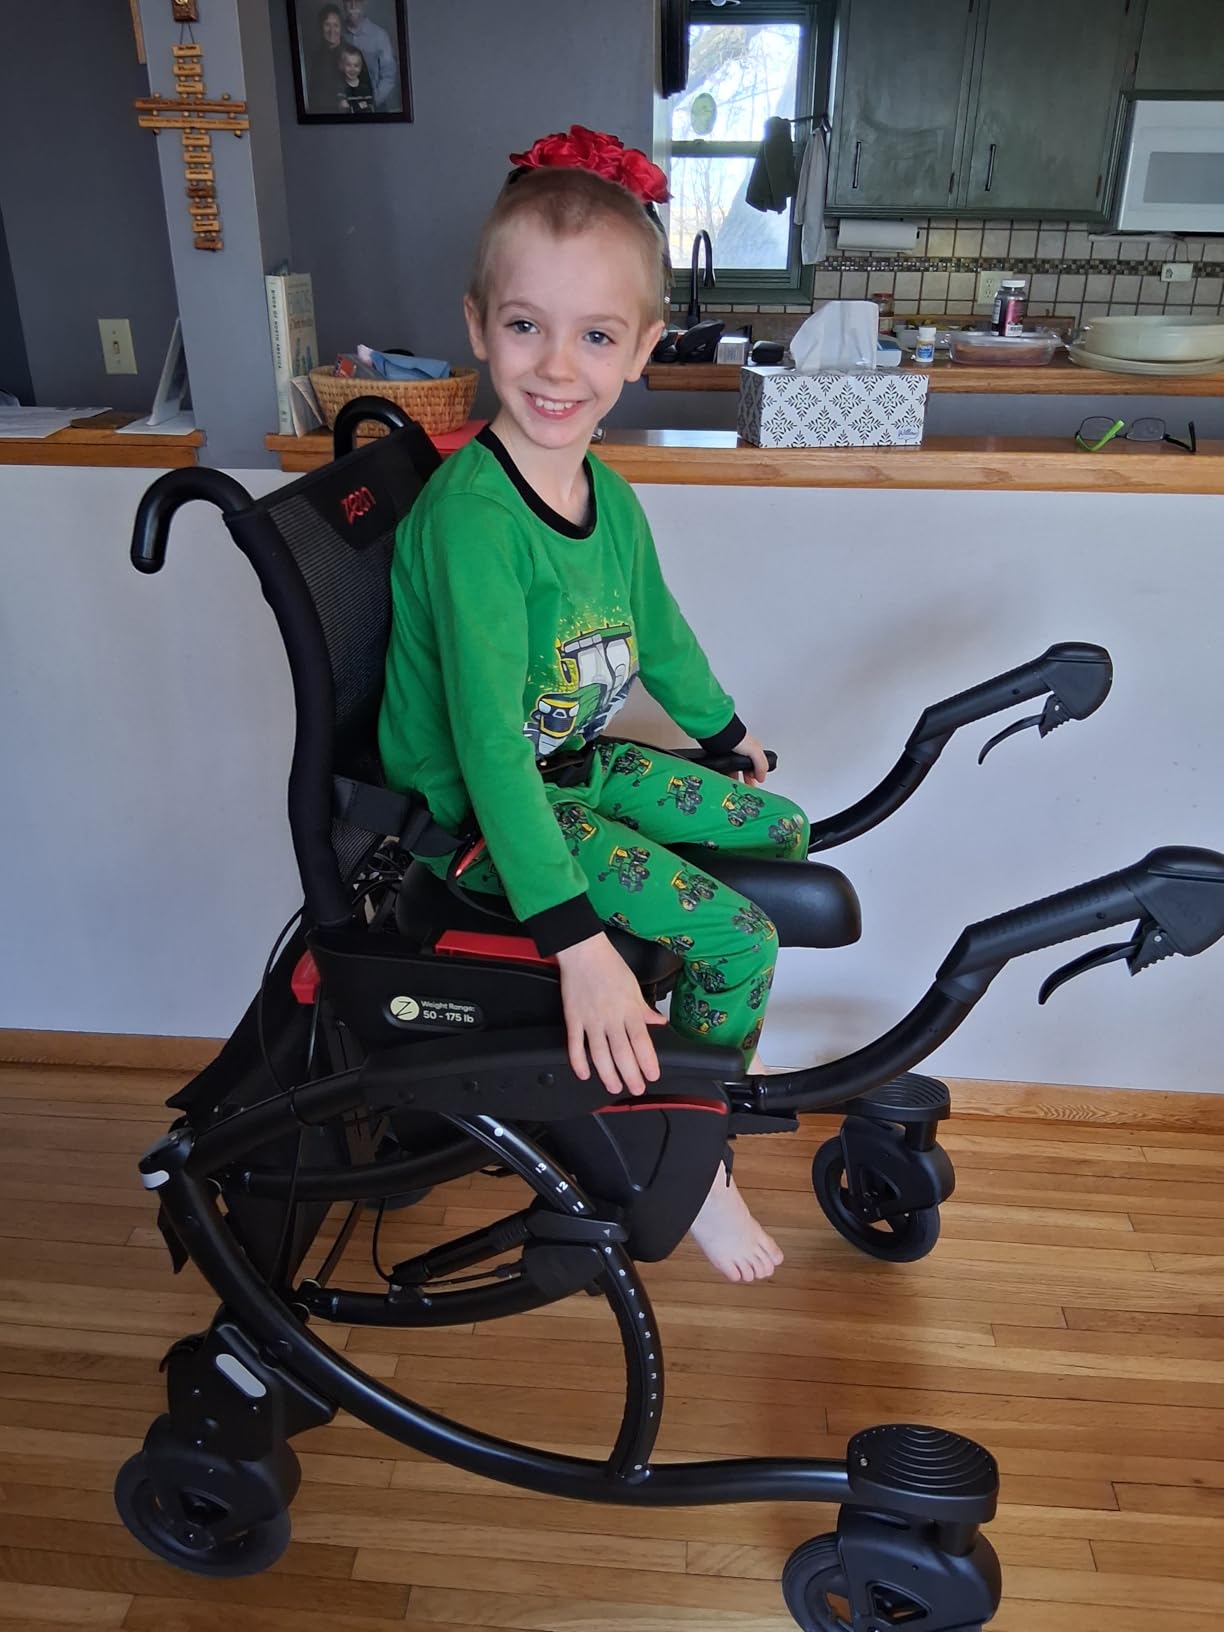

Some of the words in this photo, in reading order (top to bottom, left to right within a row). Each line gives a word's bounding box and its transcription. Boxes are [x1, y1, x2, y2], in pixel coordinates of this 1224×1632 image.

[420, 1000, 448, 1010] Weight
[423, 1010, 437, 1020] 50
[446, 1012, 462, 1022] 175
[464, 1014, 474, 1023] lb
[535, 1162, 547, 1174] 13
[556, 1181, 568, 1193] 12
[572, 1201, 584, 1212] 11
